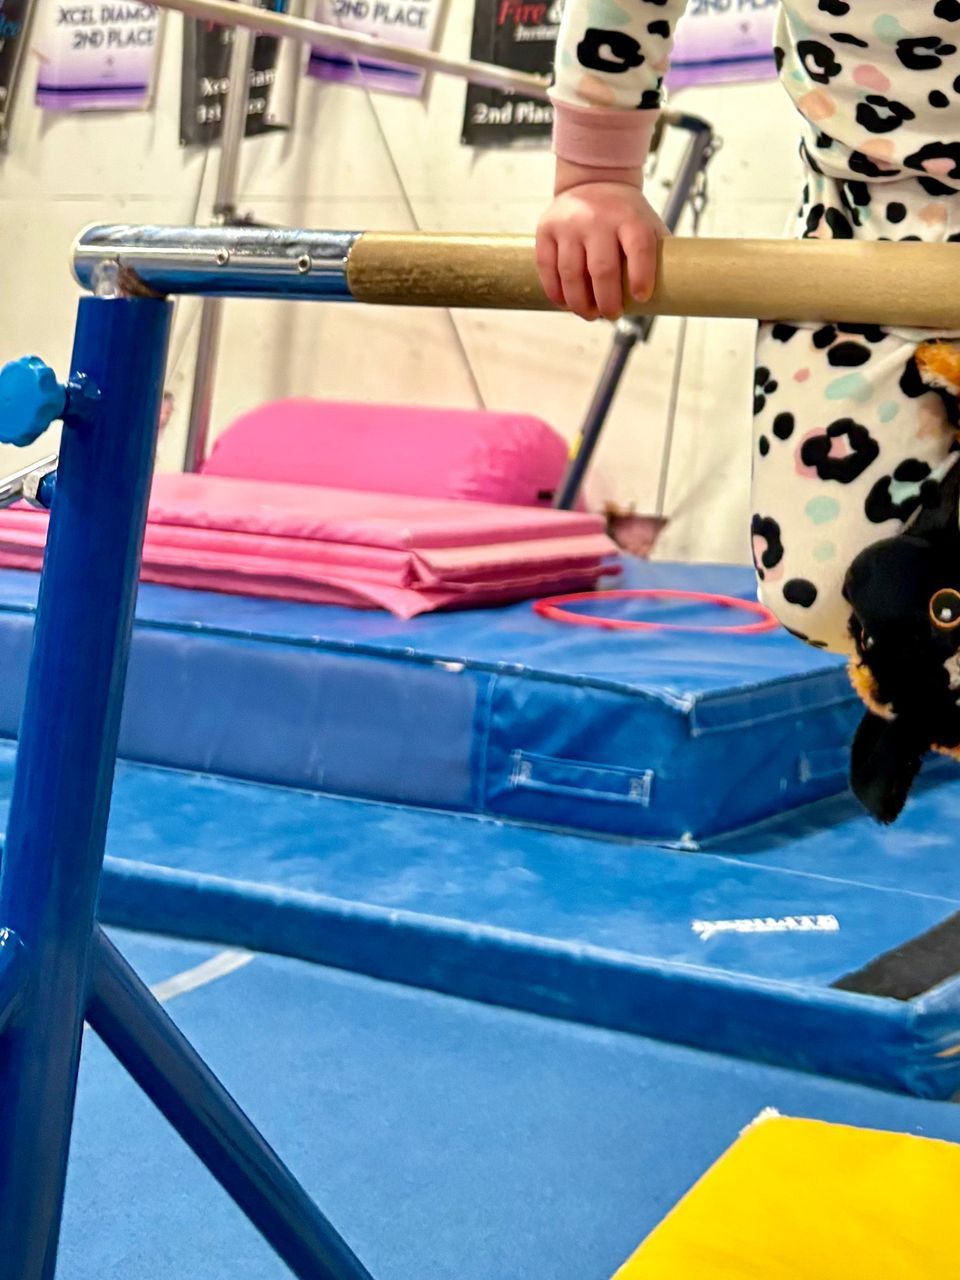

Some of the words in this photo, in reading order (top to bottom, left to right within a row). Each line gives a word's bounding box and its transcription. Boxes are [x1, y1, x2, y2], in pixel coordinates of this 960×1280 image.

[57, 5, 99, 26] XCEL
[373, 0, 430, 30] PLACE
[73, 30, 104, 50] 2ND
[107, 28, 155, 47] PLACE
[473, 100, 514, 124] 2nd
